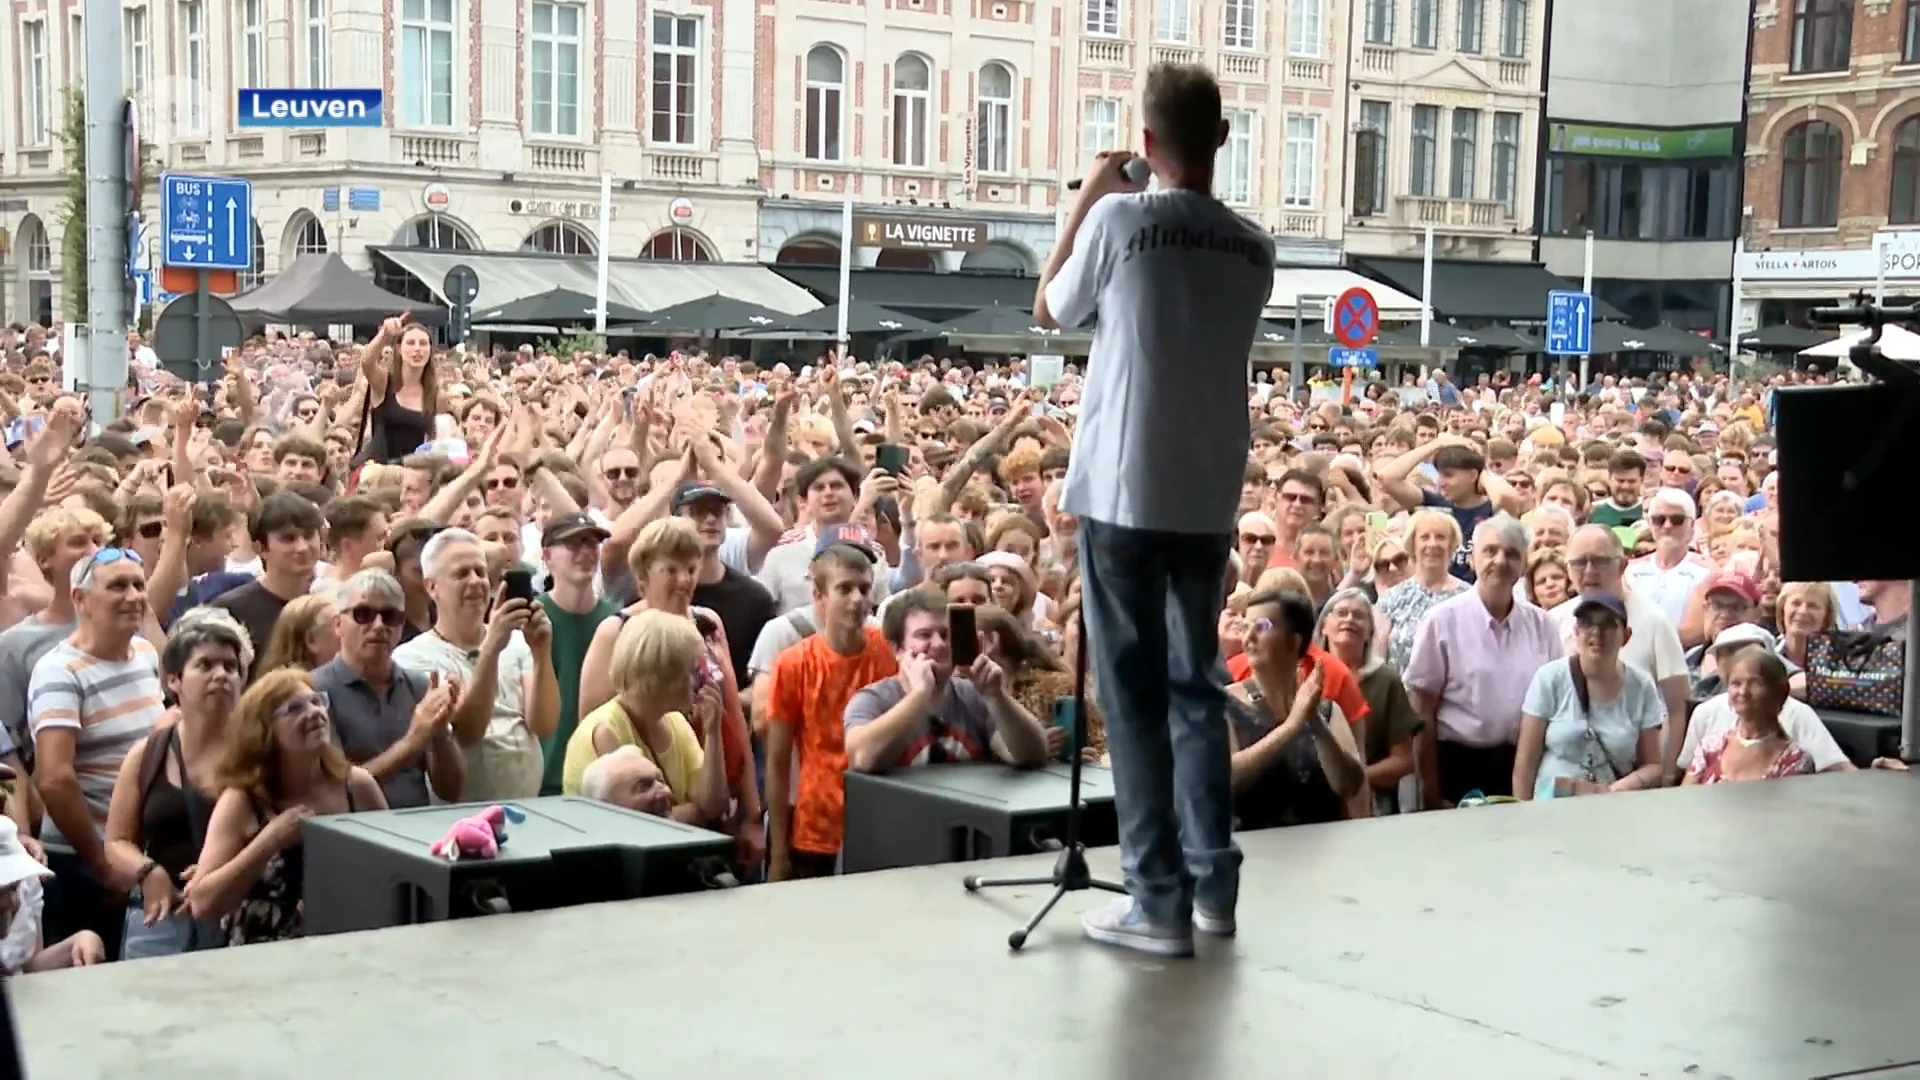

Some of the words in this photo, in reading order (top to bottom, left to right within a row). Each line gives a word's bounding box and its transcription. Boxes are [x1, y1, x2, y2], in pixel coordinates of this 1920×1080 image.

[176, 182, 201, 195] BUS
[885, 223, 904, 239] LA
[907, 224, 976, 243] VIGNETTE
[1755, 260, 1790, 270] STELLA
[1801, 259, 1837, 269] ARTOIS
